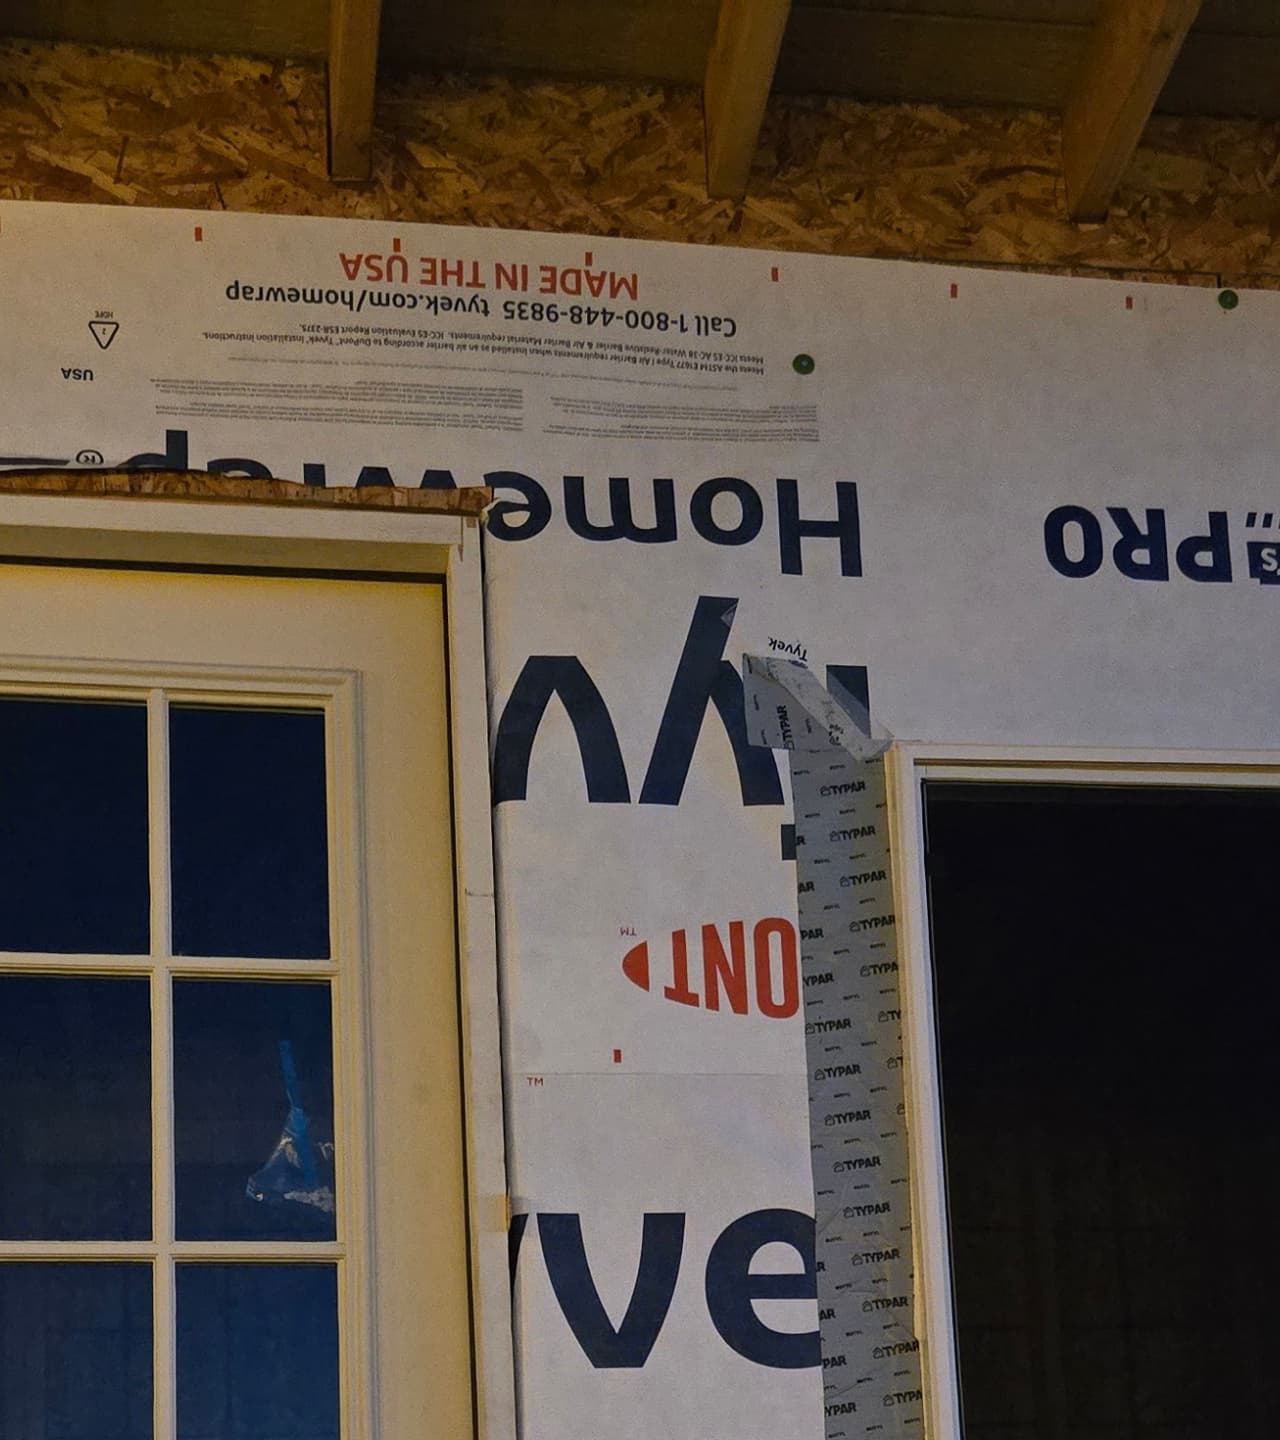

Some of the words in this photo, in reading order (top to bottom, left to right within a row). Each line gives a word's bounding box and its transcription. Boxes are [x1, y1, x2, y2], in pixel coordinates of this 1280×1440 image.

[339, 253, 408, 283] USA
[420, 257, 486, 289] THE
[496, 262, 527, 292] IN
[540, 265, 638, 300] MADE
[226, 280, 490, 317] tyvek.com/homewrap
[503, 300, 688, 333] 1-800-448-9835
[696, 316, 736, 338] Call
[60, 368, 94, 381] USA
[1044, 506, 1230, 583] PRO
[768, 636, 807, 662] Tyvek
[832, 781, 866, 796] TYPAR
[840, 826, 875, 840] TYPAR
[849, 870, 886, 887] TYPAR
[664, 918, 800, 1019] ONT
[815, 1018, 852, 1033] TYPAR
[824, 1064, 862, 1078] TYPAR
[834, 1110, 871, 1124] TYPAR
[844, 1156, 881, 1171] TYPAR
[853, 1202, 890, 1217] TYPAR
[862, 1248, 900, 1264] TYPAR
[872, 1296, 908, 1310] TYPAR
